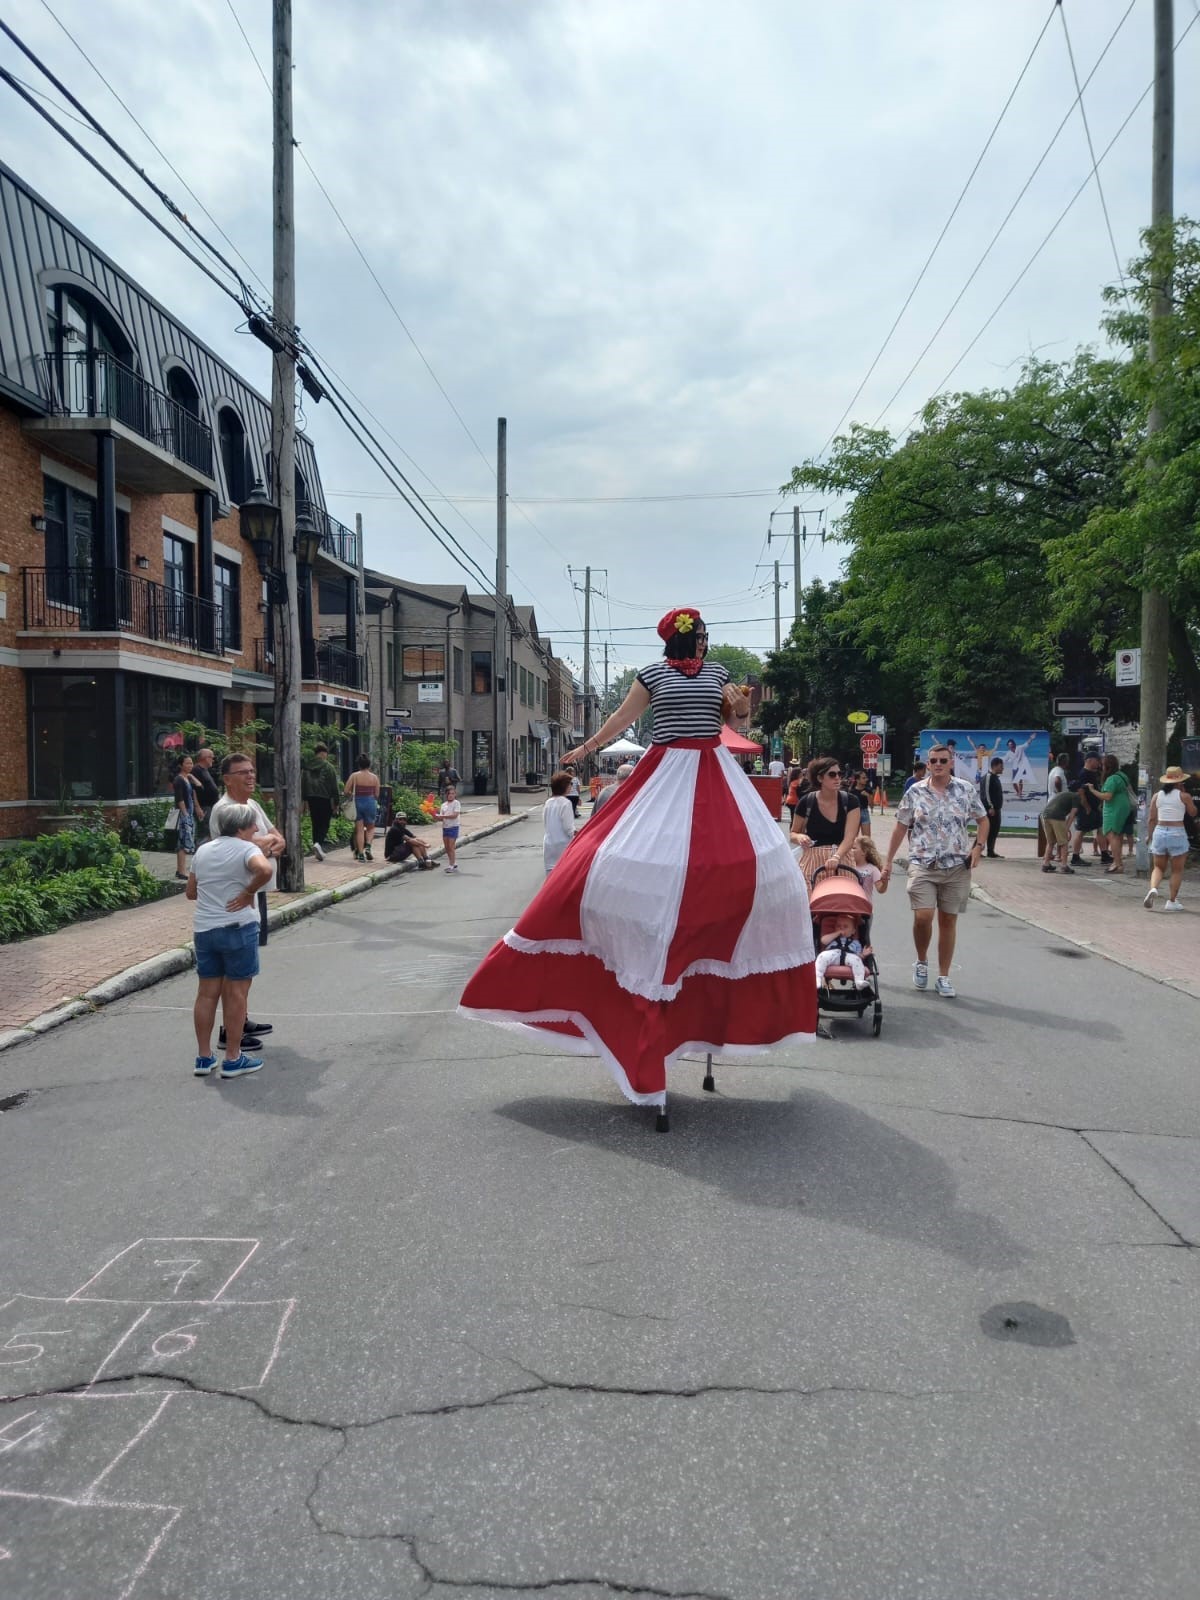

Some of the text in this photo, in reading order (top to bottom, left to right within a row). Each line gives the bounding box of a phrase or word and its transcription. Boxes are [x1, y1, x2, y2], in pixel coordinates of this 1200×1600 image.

[862, 739, 880, 748] STOP
[153, 1258, 202, 1295] 7
[0, 1328, 73, 1366] 5
[151, 1321, 211, 1359] 6
